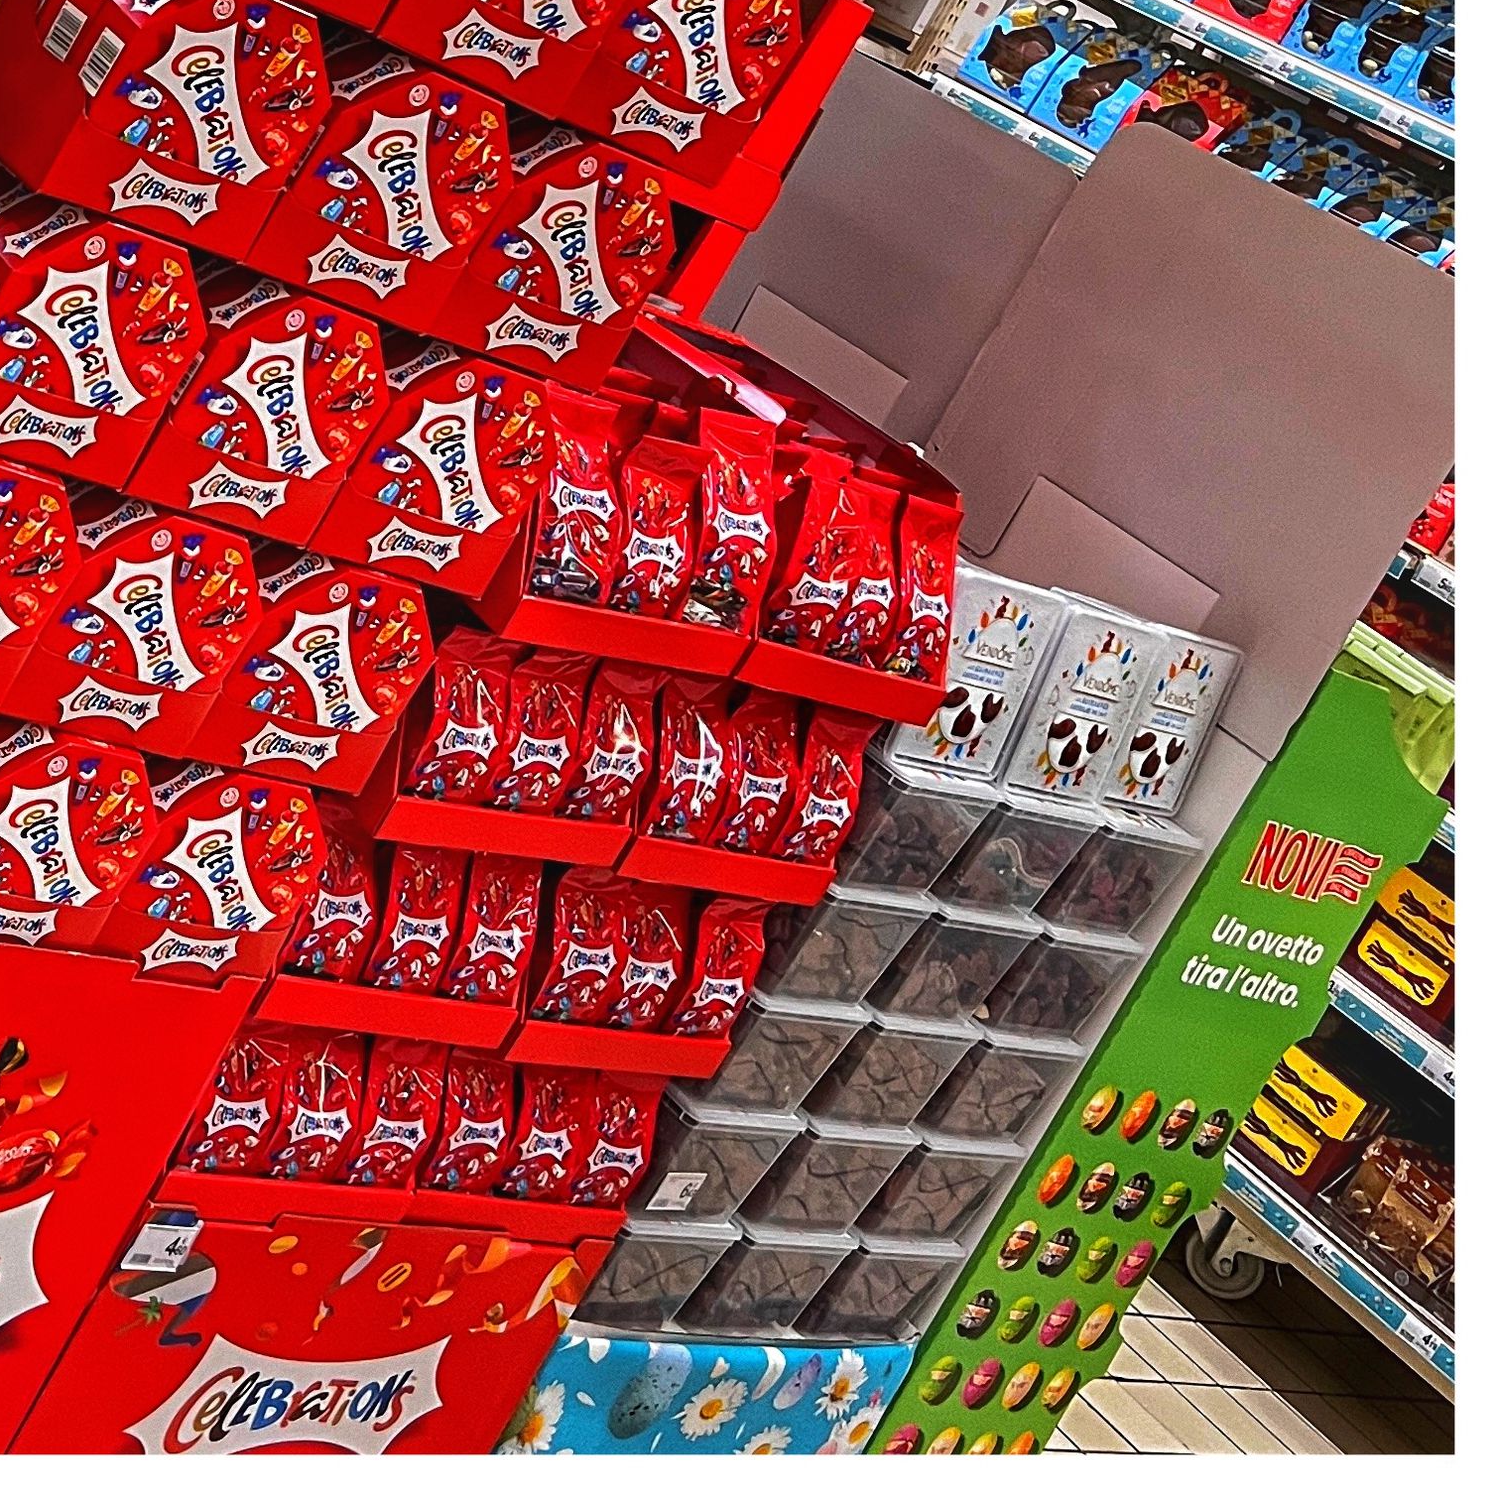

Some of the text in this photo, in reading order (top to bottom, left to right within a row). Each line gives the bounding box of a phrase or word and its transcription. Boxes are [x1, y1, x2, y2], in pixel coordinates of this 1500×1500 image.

[1212, 914, 1324, 965] Un ovetto
[1181, 954, 1229, 990] tira
